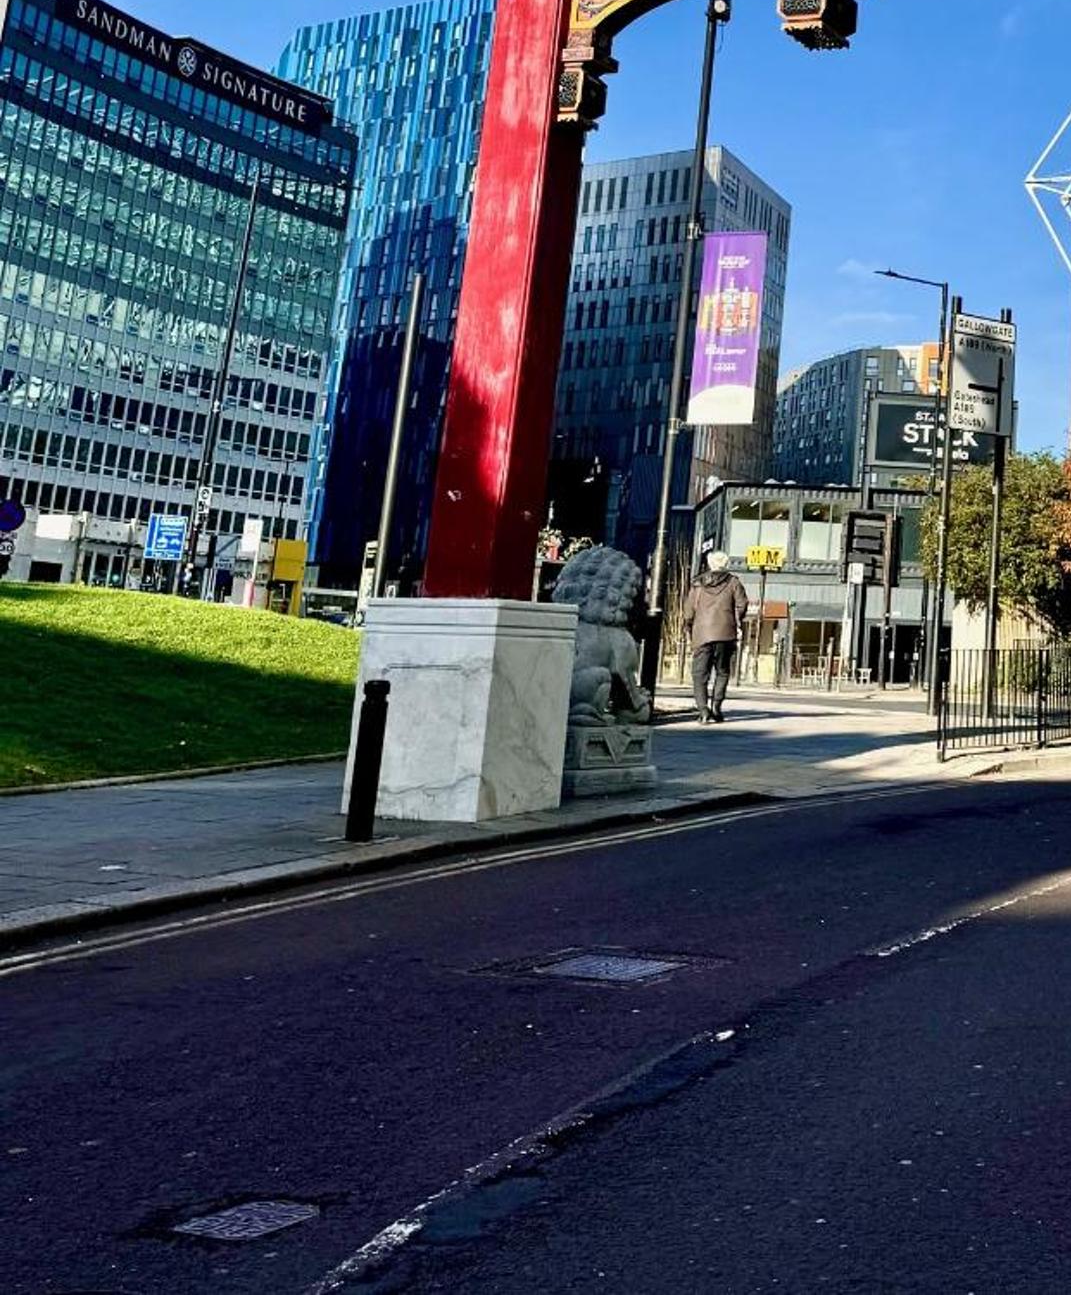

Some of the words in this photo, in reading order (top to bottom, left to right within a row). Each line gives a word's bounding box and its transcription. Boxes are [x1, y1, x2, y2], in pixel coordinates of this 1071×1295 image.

[76, 0, 172, 63] SANDMAN
[202, 63, 308, 123] SIGNATURE
[958, 318, 1013, 338] GALLOWGATE
[902, 422, 979, 447] STK
